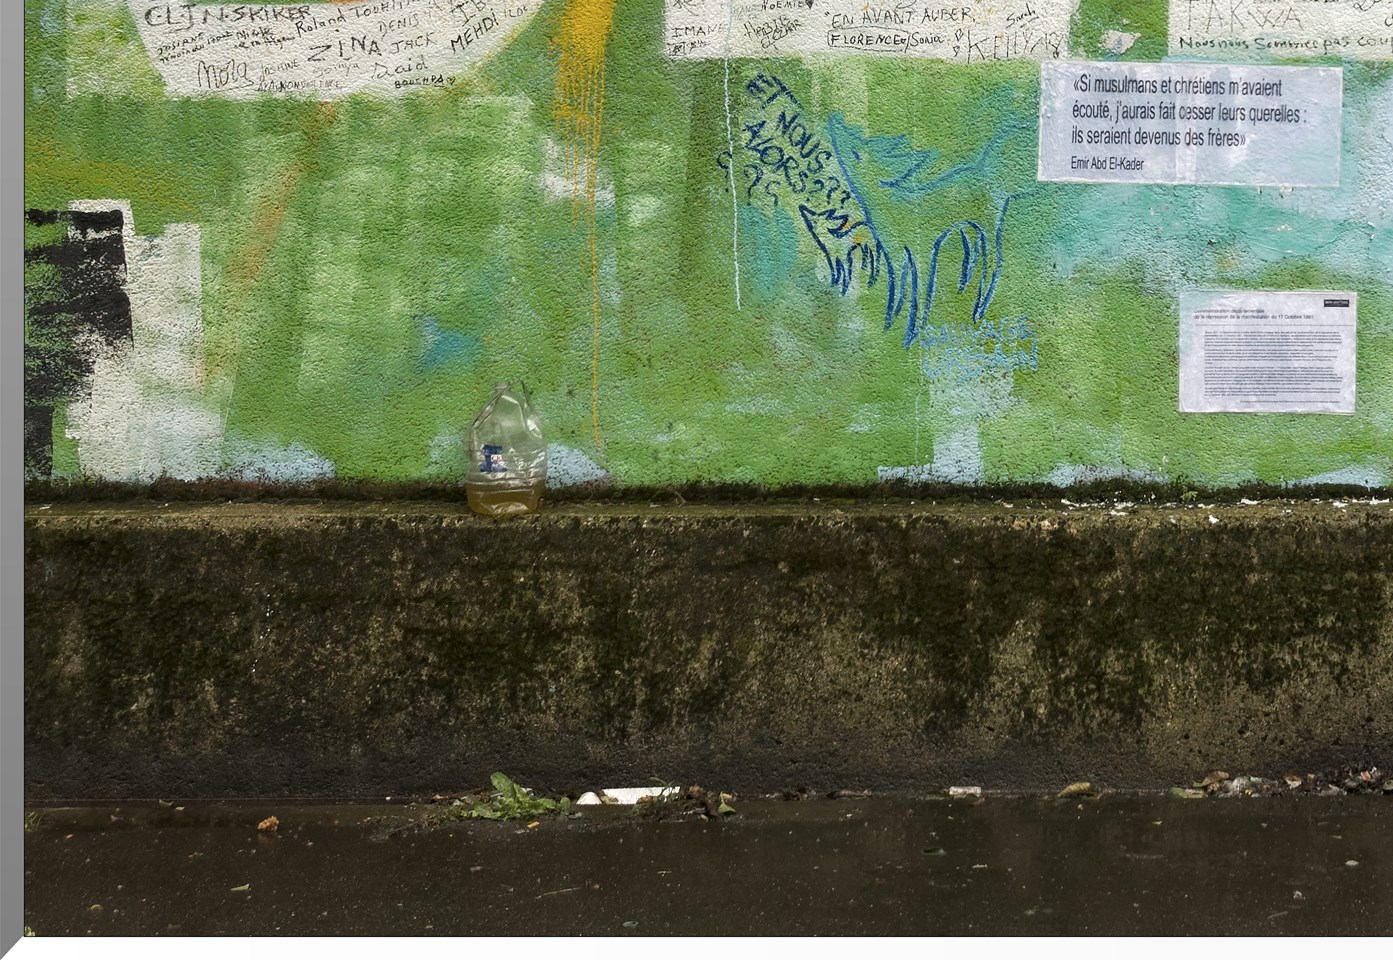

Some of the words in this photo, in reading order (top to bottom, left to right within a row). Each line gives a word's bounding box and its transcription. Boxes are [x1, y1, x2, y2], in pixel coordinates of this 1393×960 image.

[1094, 76, 1158, 94] musulmans
[1161, 78, 1172, 93] et
[1174, 76, 1225, 95] chrétiens
[1228, 79, 1282, 97] m'avaient
[1072, 102, 1113, 122] écouté,
[1115, 101, 1156, 124] j'aurais
[1158, 102, 1176, 120] fait
[1178, 105, 1216, 121] cesser
[1218, 104, 1246, 121] leurs
[1249, 105, 1300, 126] querelles
[1071, 126, 1084, 144] ils
[1086, 127, 1131, 145] seraient
[1134, 128, 1181, 145] devenus
[1184, 128, 1205, 146] des
[1207, 129, 1246, 147] frères»
[1071, 156, 1090, 170] Emir
[1091, 156, 1107, 170] Abd
[1109, 156, 1144, 171] El-Kader
